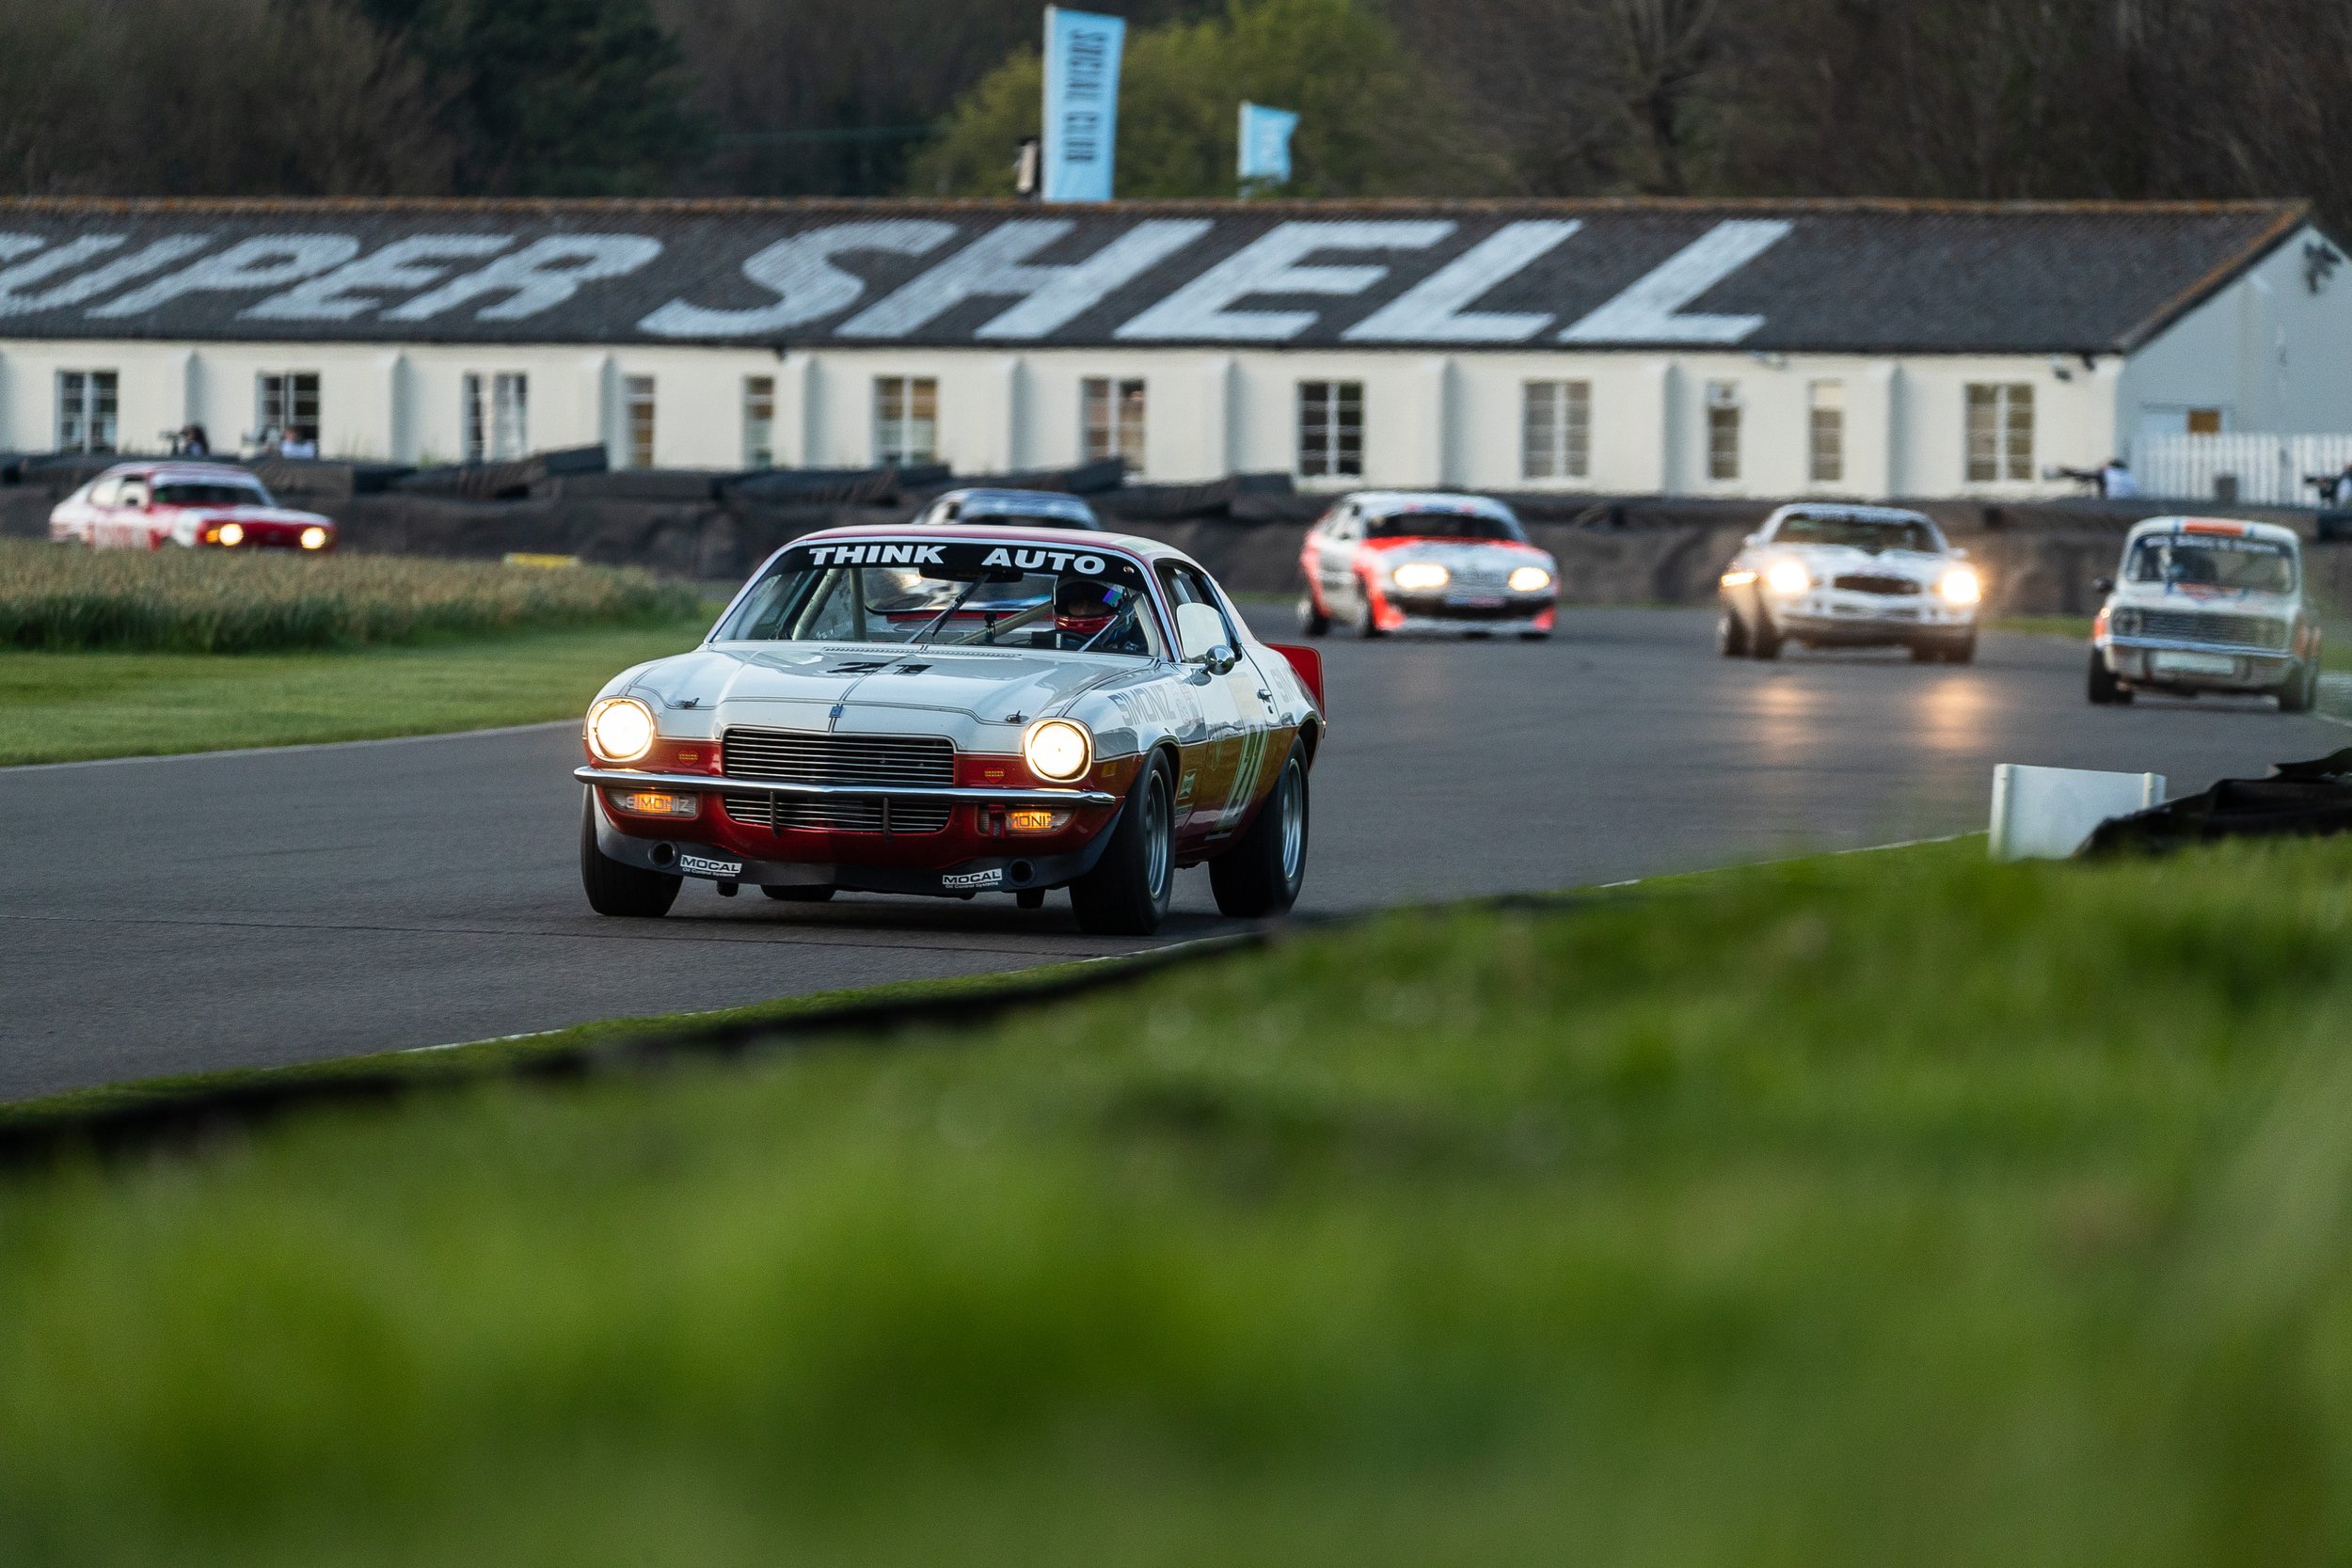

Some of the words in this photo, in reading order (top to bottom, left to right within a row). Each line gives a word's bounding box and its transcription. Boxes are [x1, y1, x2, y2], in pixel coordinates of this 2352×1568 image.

[0, 232, 663, 321] UPER
[637, 217, 1795, 344] SHELL
[808, 545, 948, 566] THINK
[980, 546, 1107, 576] AUTO
[826, 661, 934, 674] 21
[1107, 684, 1177, 727] SIMONIZ
[626, 795, 690, 813] SIMONIZ
[1005, 815, 1057, 828] MONIZ
[681, 856, 740, 872] MOCAL
[944, 870, 1001, 883] MOCAL
